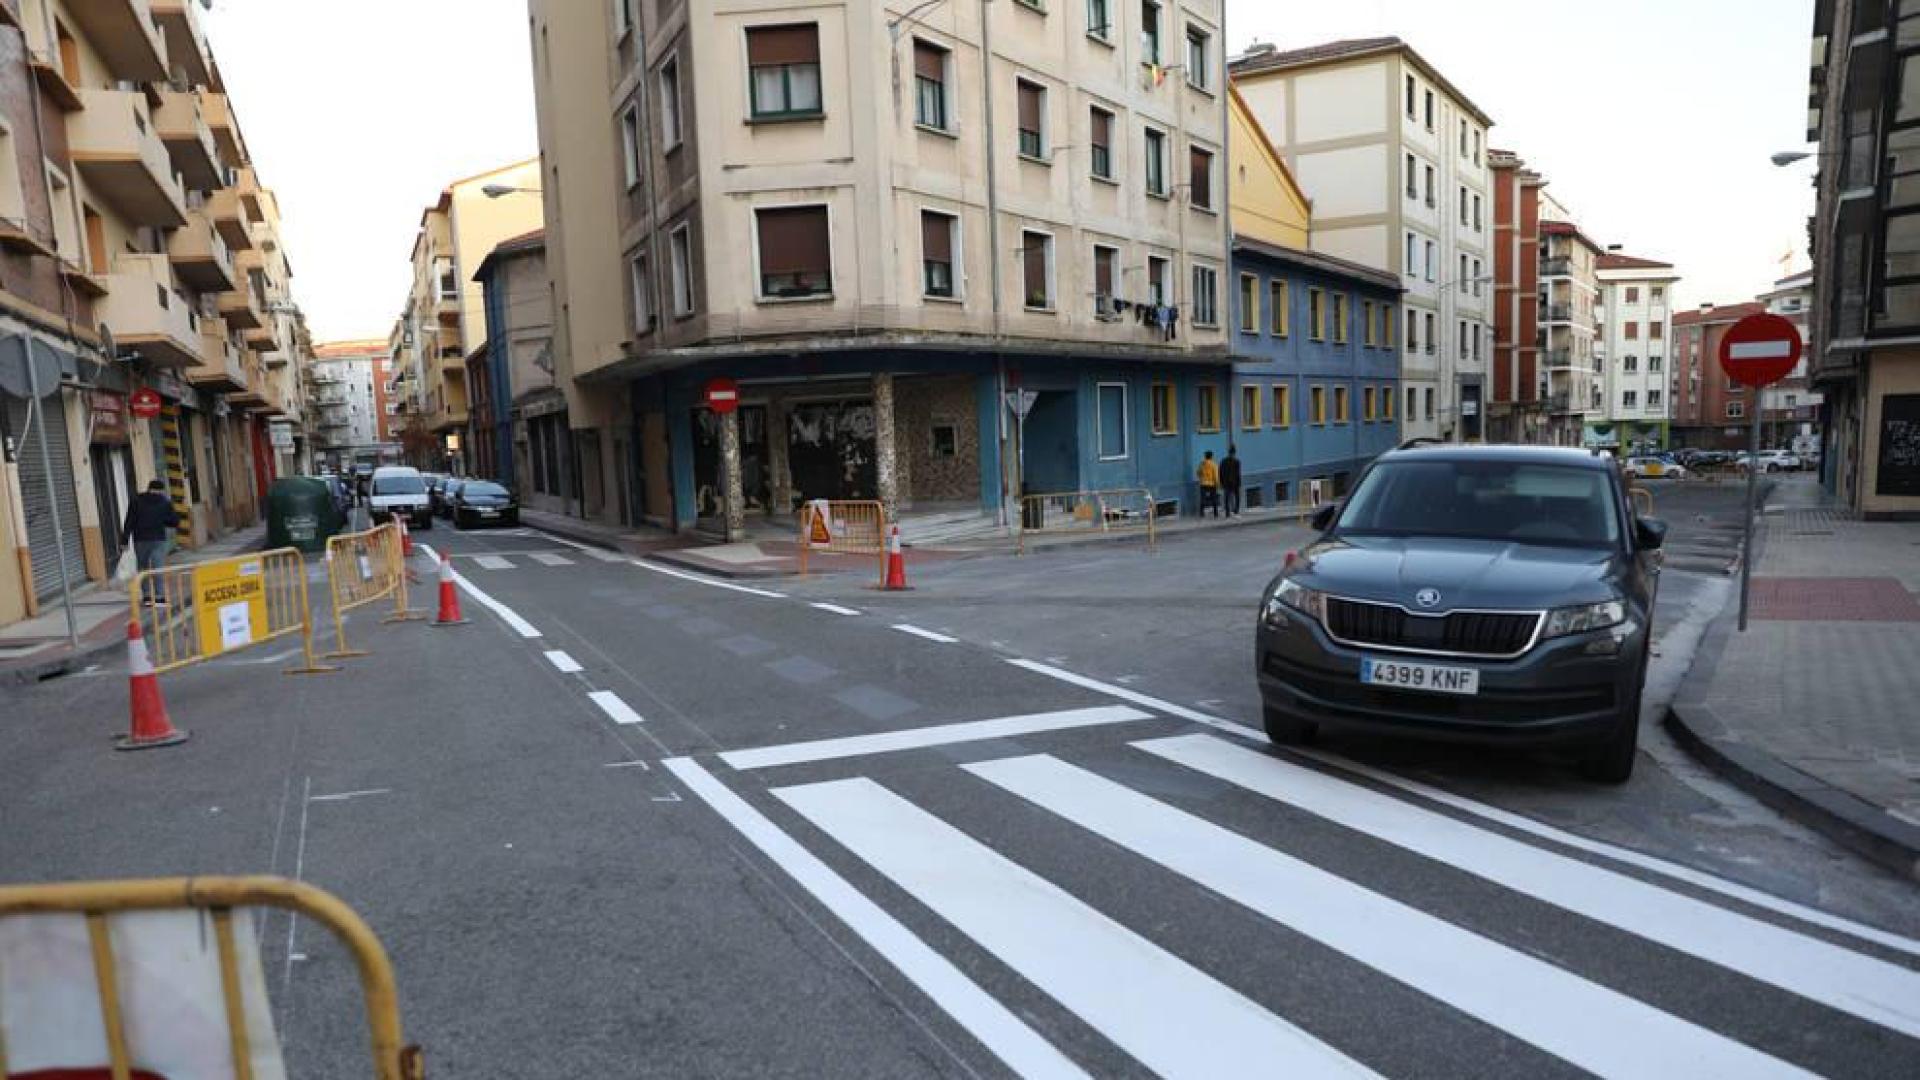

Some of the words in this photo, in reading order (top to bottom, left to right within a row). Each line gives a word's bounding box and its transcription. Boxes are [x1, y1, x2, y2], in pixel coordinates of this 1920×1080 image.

[203, 584, 237, 603] ACCESO
[1374, 662, 1425, 685] 4399
[1430, 667, 1473, 689] KNF
